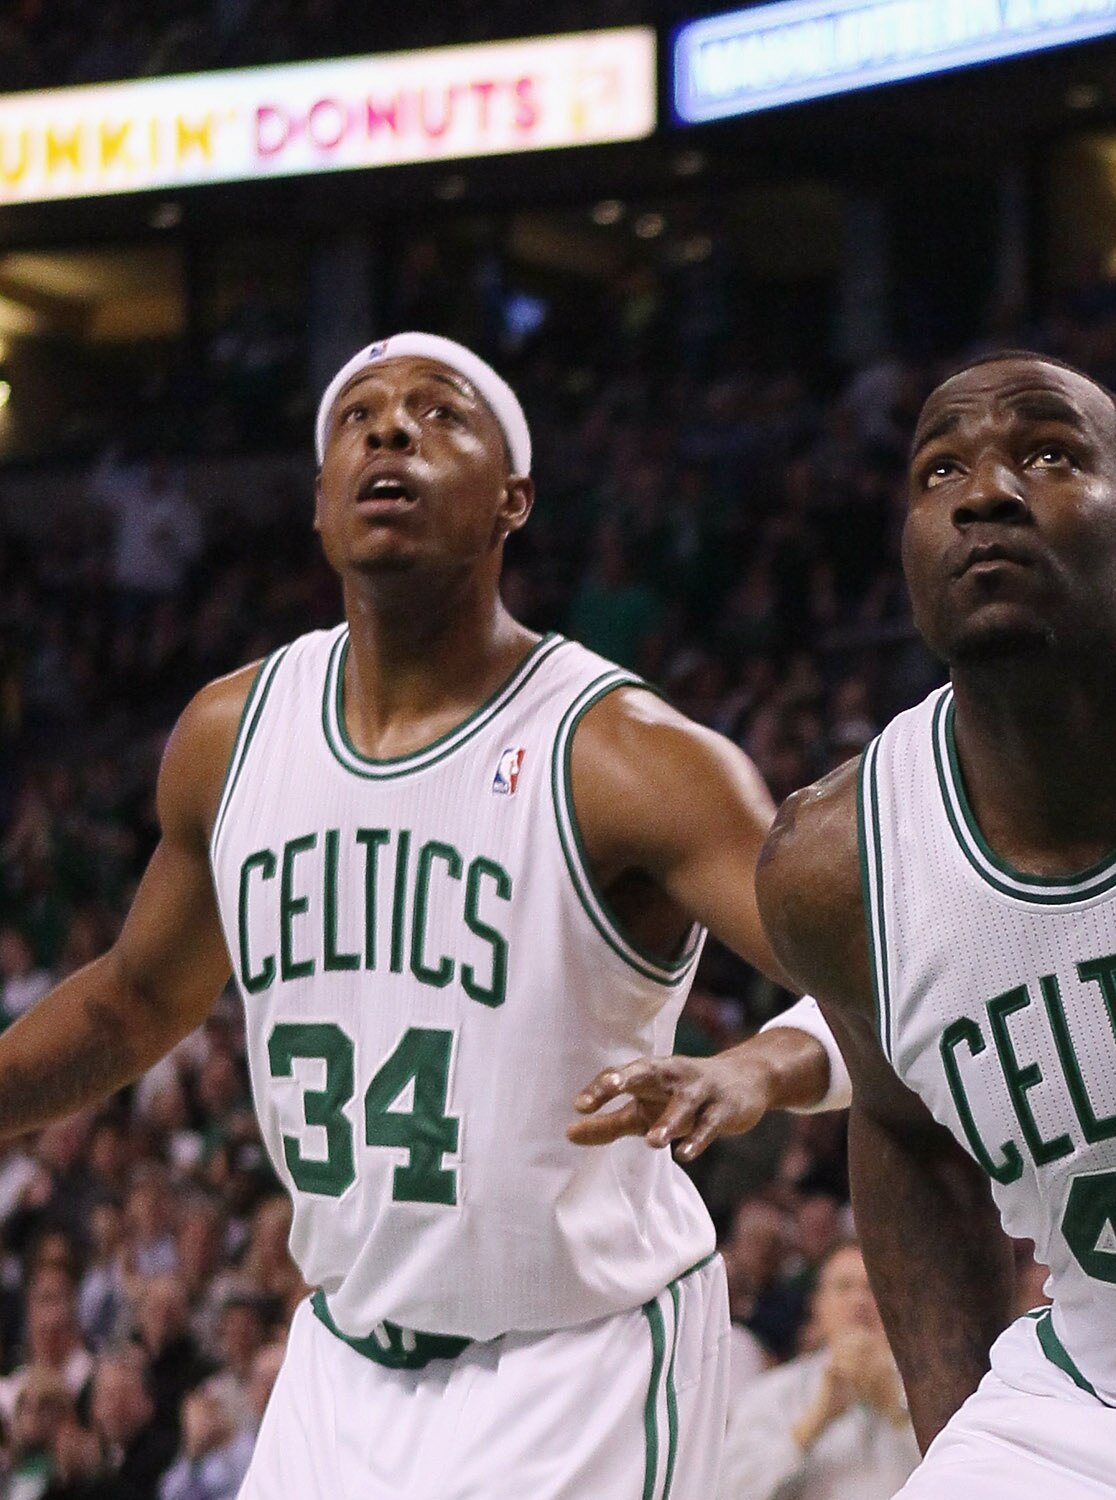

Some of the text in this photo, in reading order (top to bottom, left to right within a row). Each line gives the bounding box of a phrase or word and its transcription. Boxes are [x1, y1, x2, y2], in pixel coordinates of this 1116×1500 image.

[255, 73, 539, 158] DONUTS
[238, 828, 513, 1009] CELTICS
[267, 1022, 461, 1206] 34
